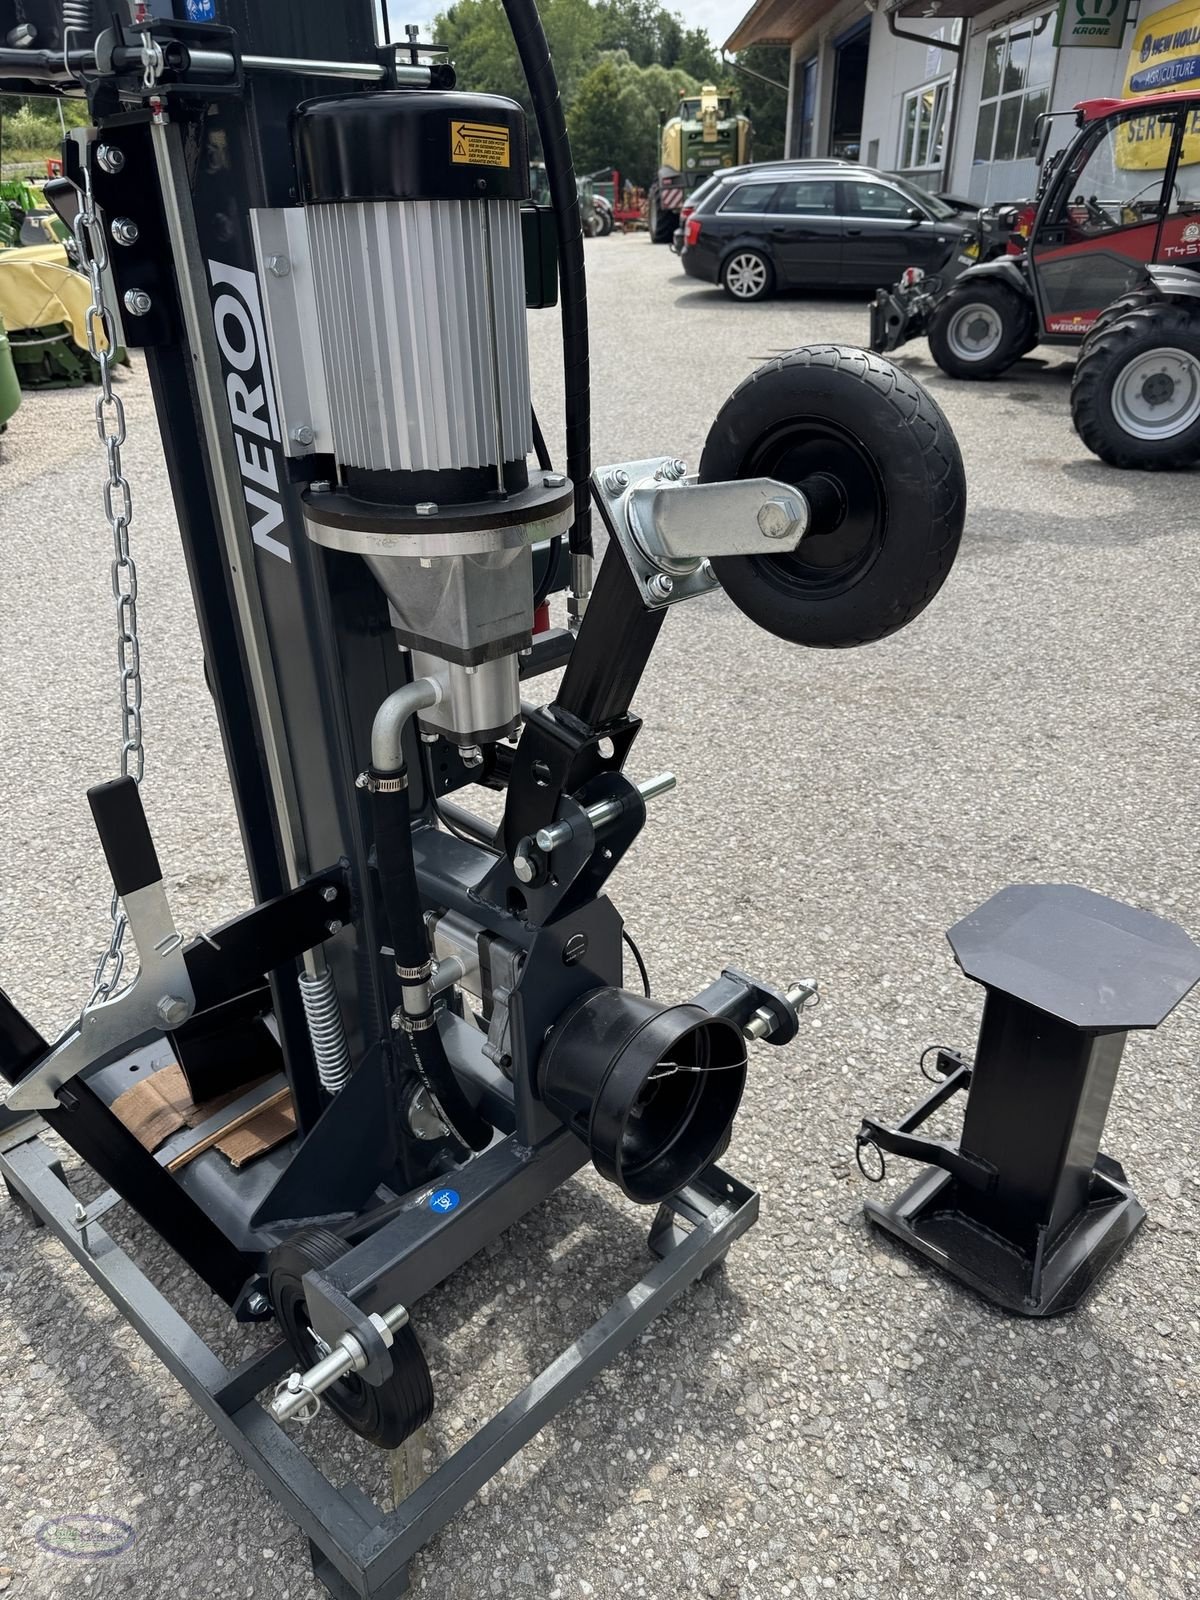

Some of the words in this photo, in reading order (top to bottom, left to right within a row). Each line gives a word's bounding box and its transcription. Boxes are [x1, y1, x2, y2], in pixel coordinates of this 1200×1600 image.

[1072, 26, 1111, 36] KRONE
[1151, 34, 1173, 57] NEW
[1145, 61, 1196, 86] AGRICULTURE
[213, 294, 292, 564] NERO
